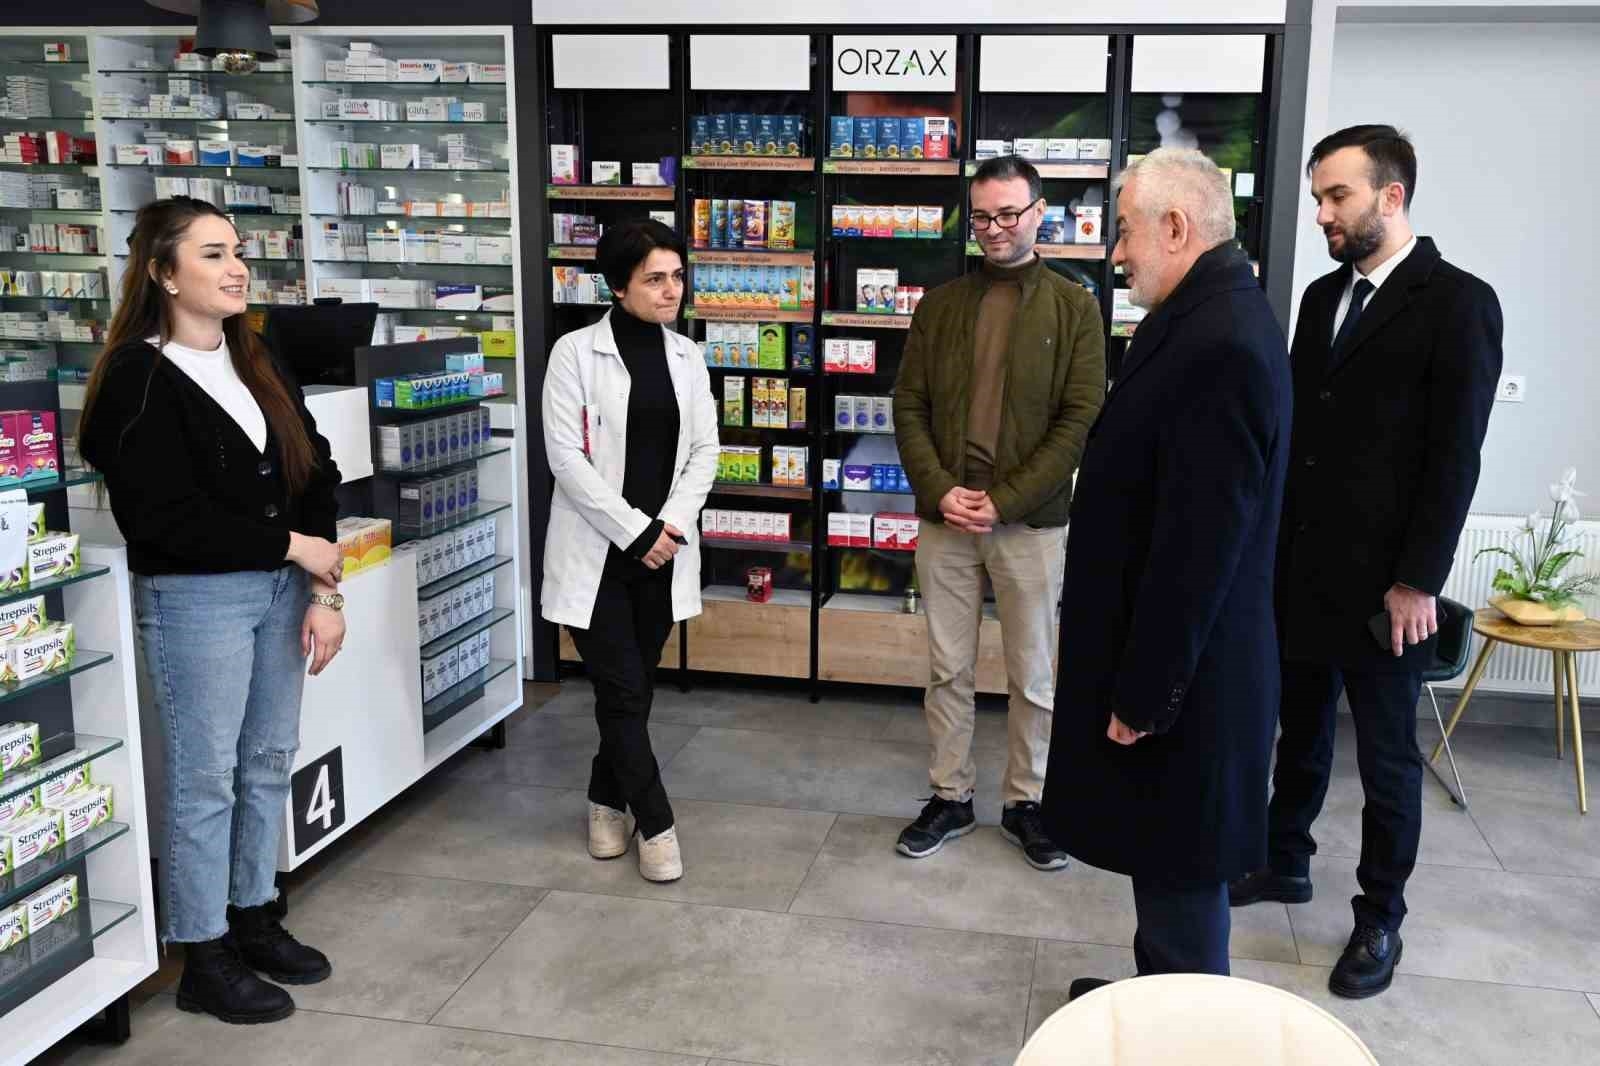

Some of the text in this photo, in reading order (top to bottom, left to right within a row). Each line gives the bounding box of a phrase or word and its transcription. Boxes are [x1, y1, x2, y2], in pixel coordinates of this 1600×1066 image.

[838, 48, 947, 76] ORZAX
[32, 542, 67, 558] Strepsils
[23, 638, 64, 659] Strepsils
[0, 731, 33, 751] repsils
[69, 795, 107, 819] Strepsils
[306, 763, 336, 830] 4
[17, 820, 58, 847] Strepsils
[32, 887, 72, 914] Strepsils
[0, 914, 21, 935] psils
